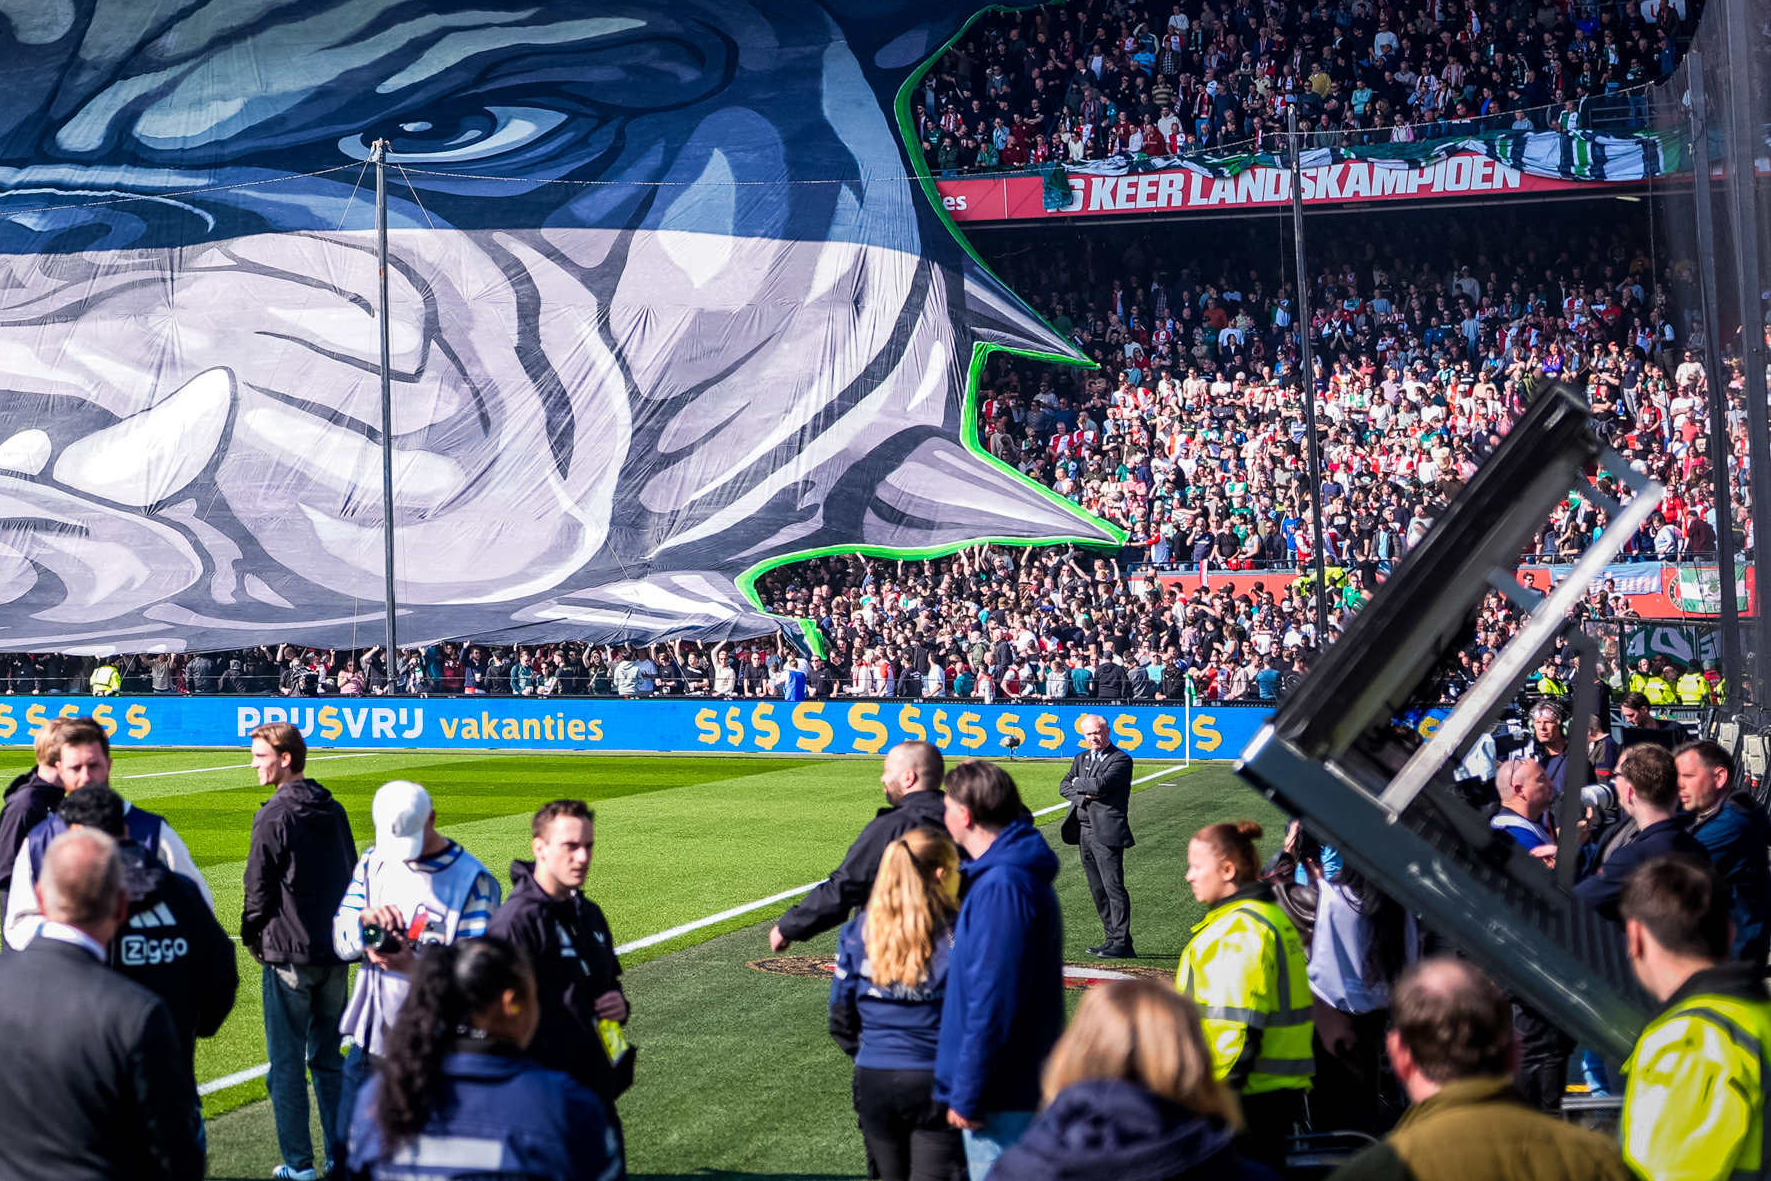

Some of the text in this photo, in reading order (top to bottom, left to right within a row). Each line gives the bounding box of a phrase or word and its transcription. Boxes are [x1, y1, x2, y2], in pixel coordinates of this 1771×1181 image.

[1088, 172, 1185, 211] KEER
[1187, 155, 1522, 207] LANDSKAMPIOEN
[438, 711, 604, 742] vakanties
